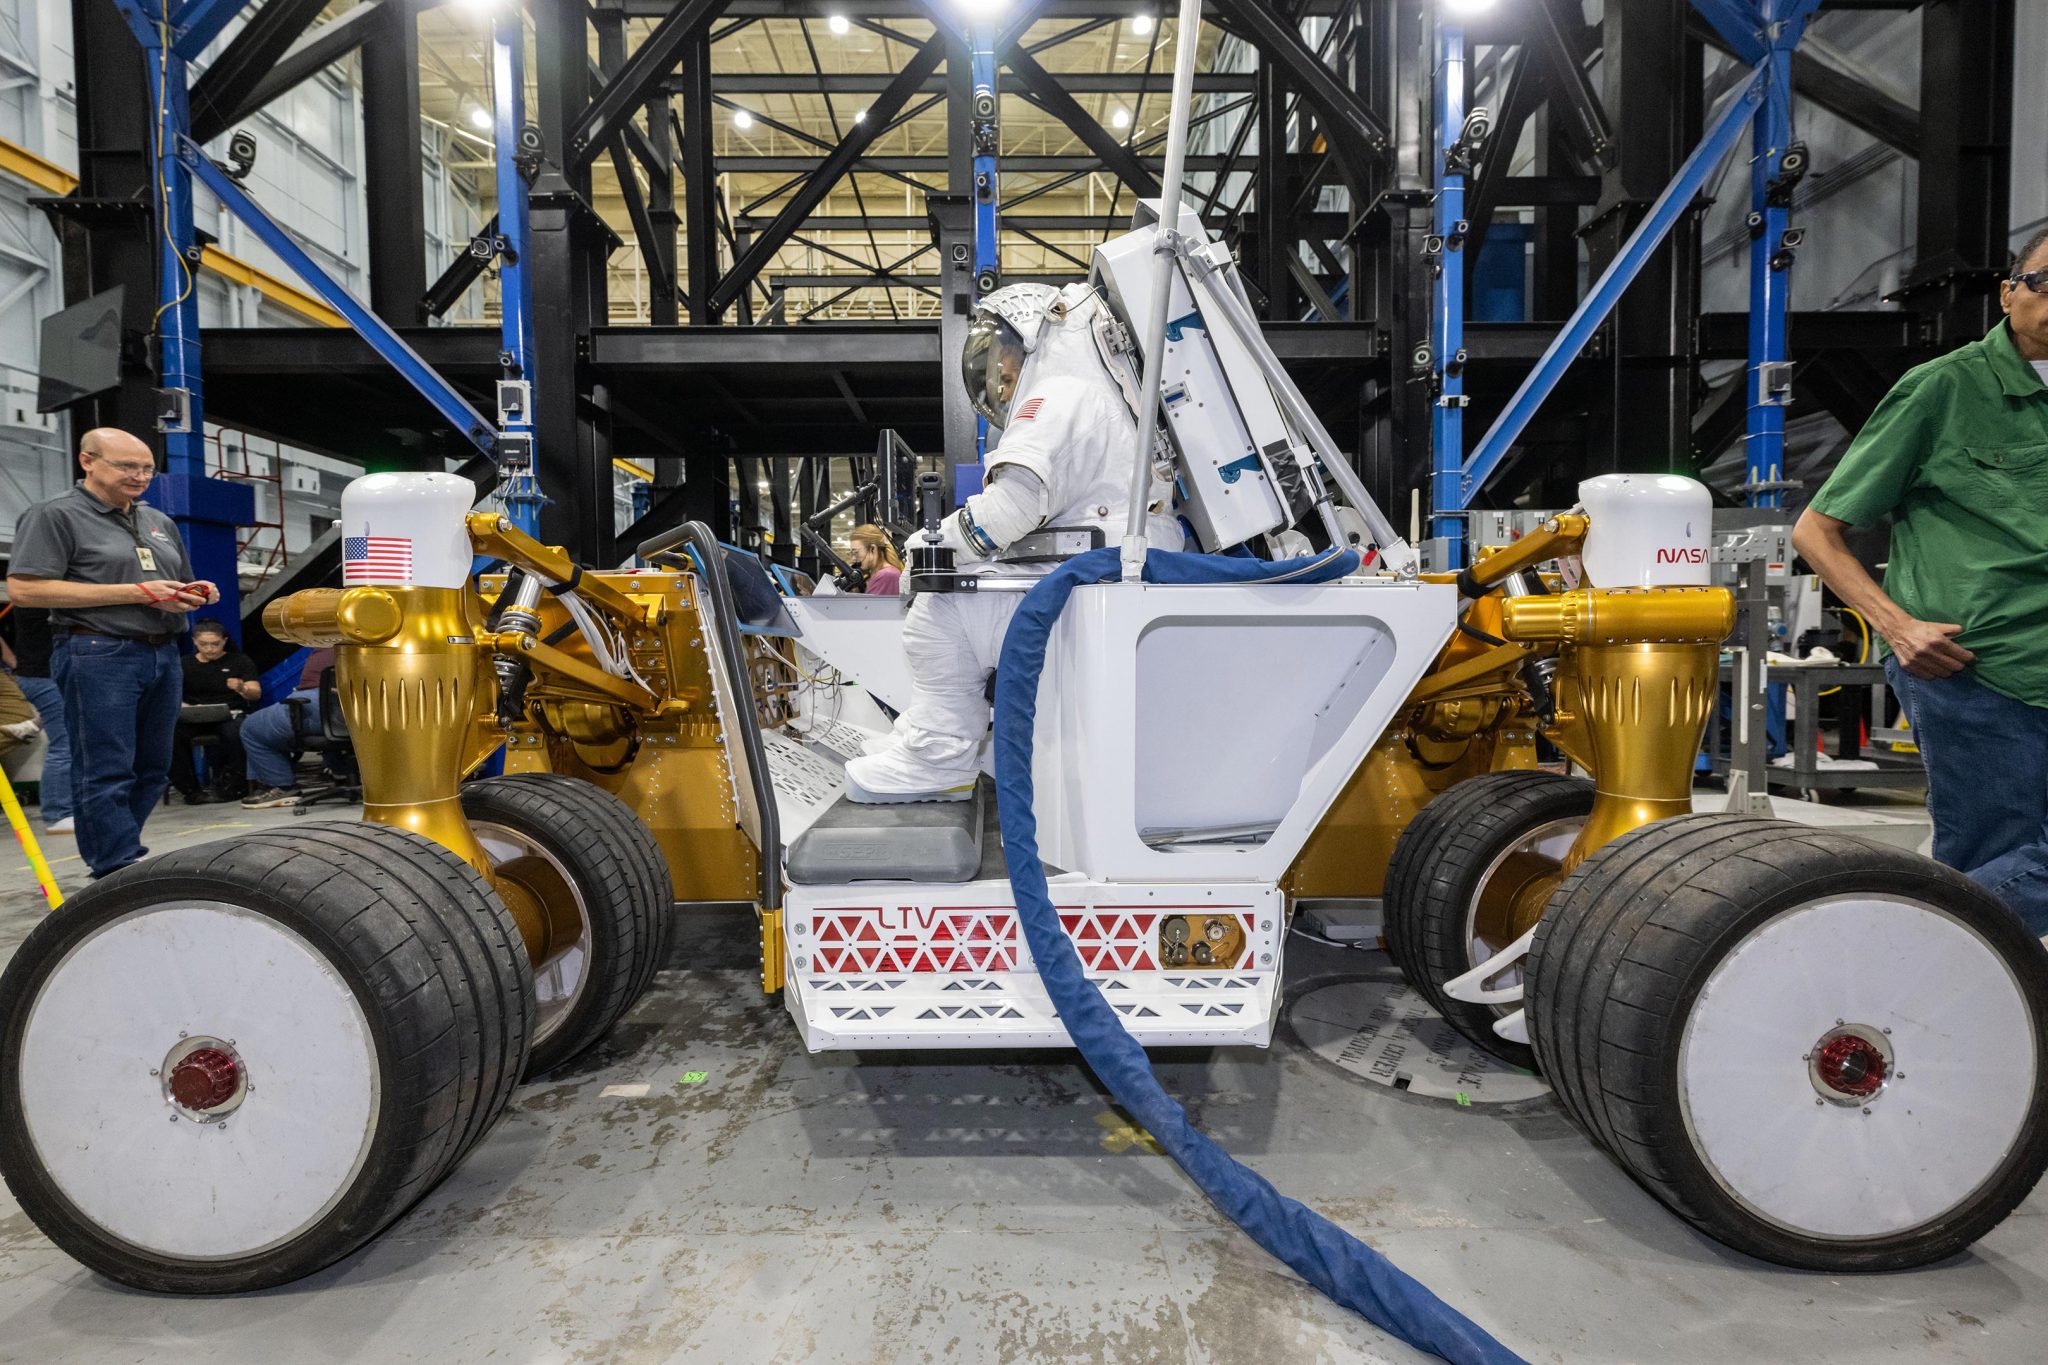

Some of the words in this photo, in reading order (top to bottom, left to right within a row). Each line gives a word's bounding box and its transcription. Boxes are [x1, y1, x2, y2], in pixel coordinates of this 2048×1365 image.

[1657, 548, 1709, 564] NASA
[879, 907, 936, 929] LTV
[1369, 1043, 1407, 1078] COVER
